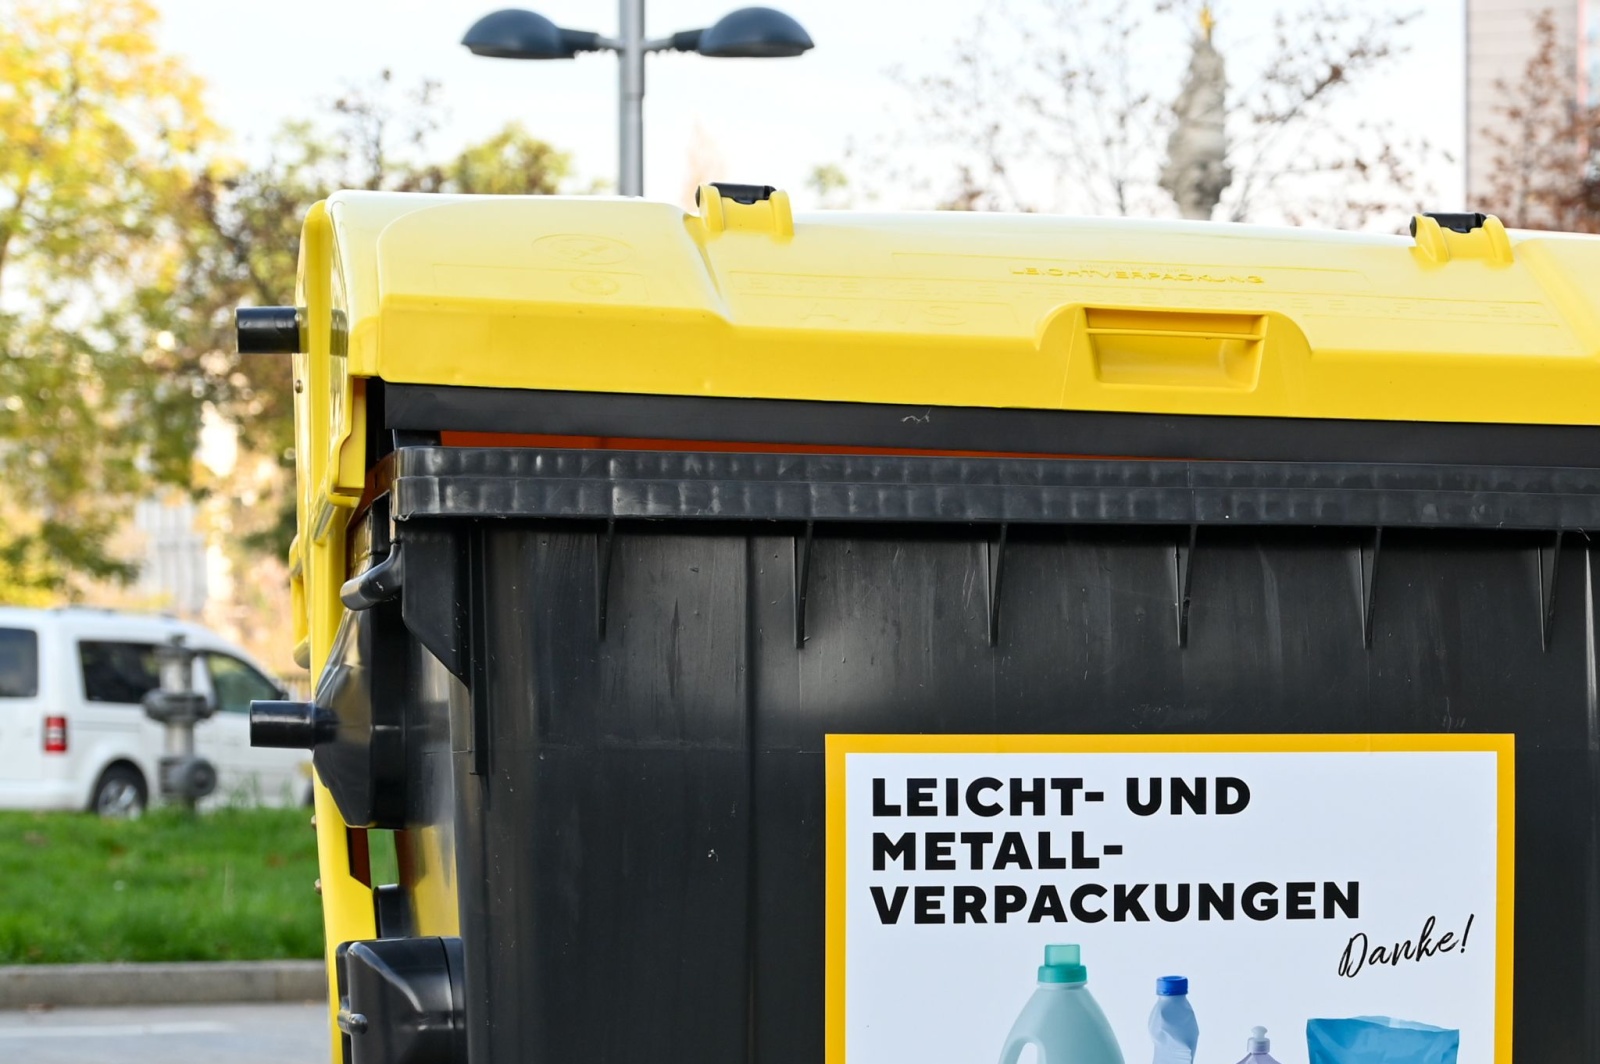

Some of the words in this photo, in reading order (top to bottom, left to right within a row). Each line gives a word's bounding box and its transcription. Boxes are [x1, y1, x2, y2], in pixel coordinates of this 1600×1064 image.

[871, 776, 1105, 818] LEICHT-
[1126, 776, 1252, 817] UND
[871, 830, 1124, 871] METALL-
[869, 881, 1361, 925] VERPACKUNGEN
[1337, 913, 1476, 979] Danke!
